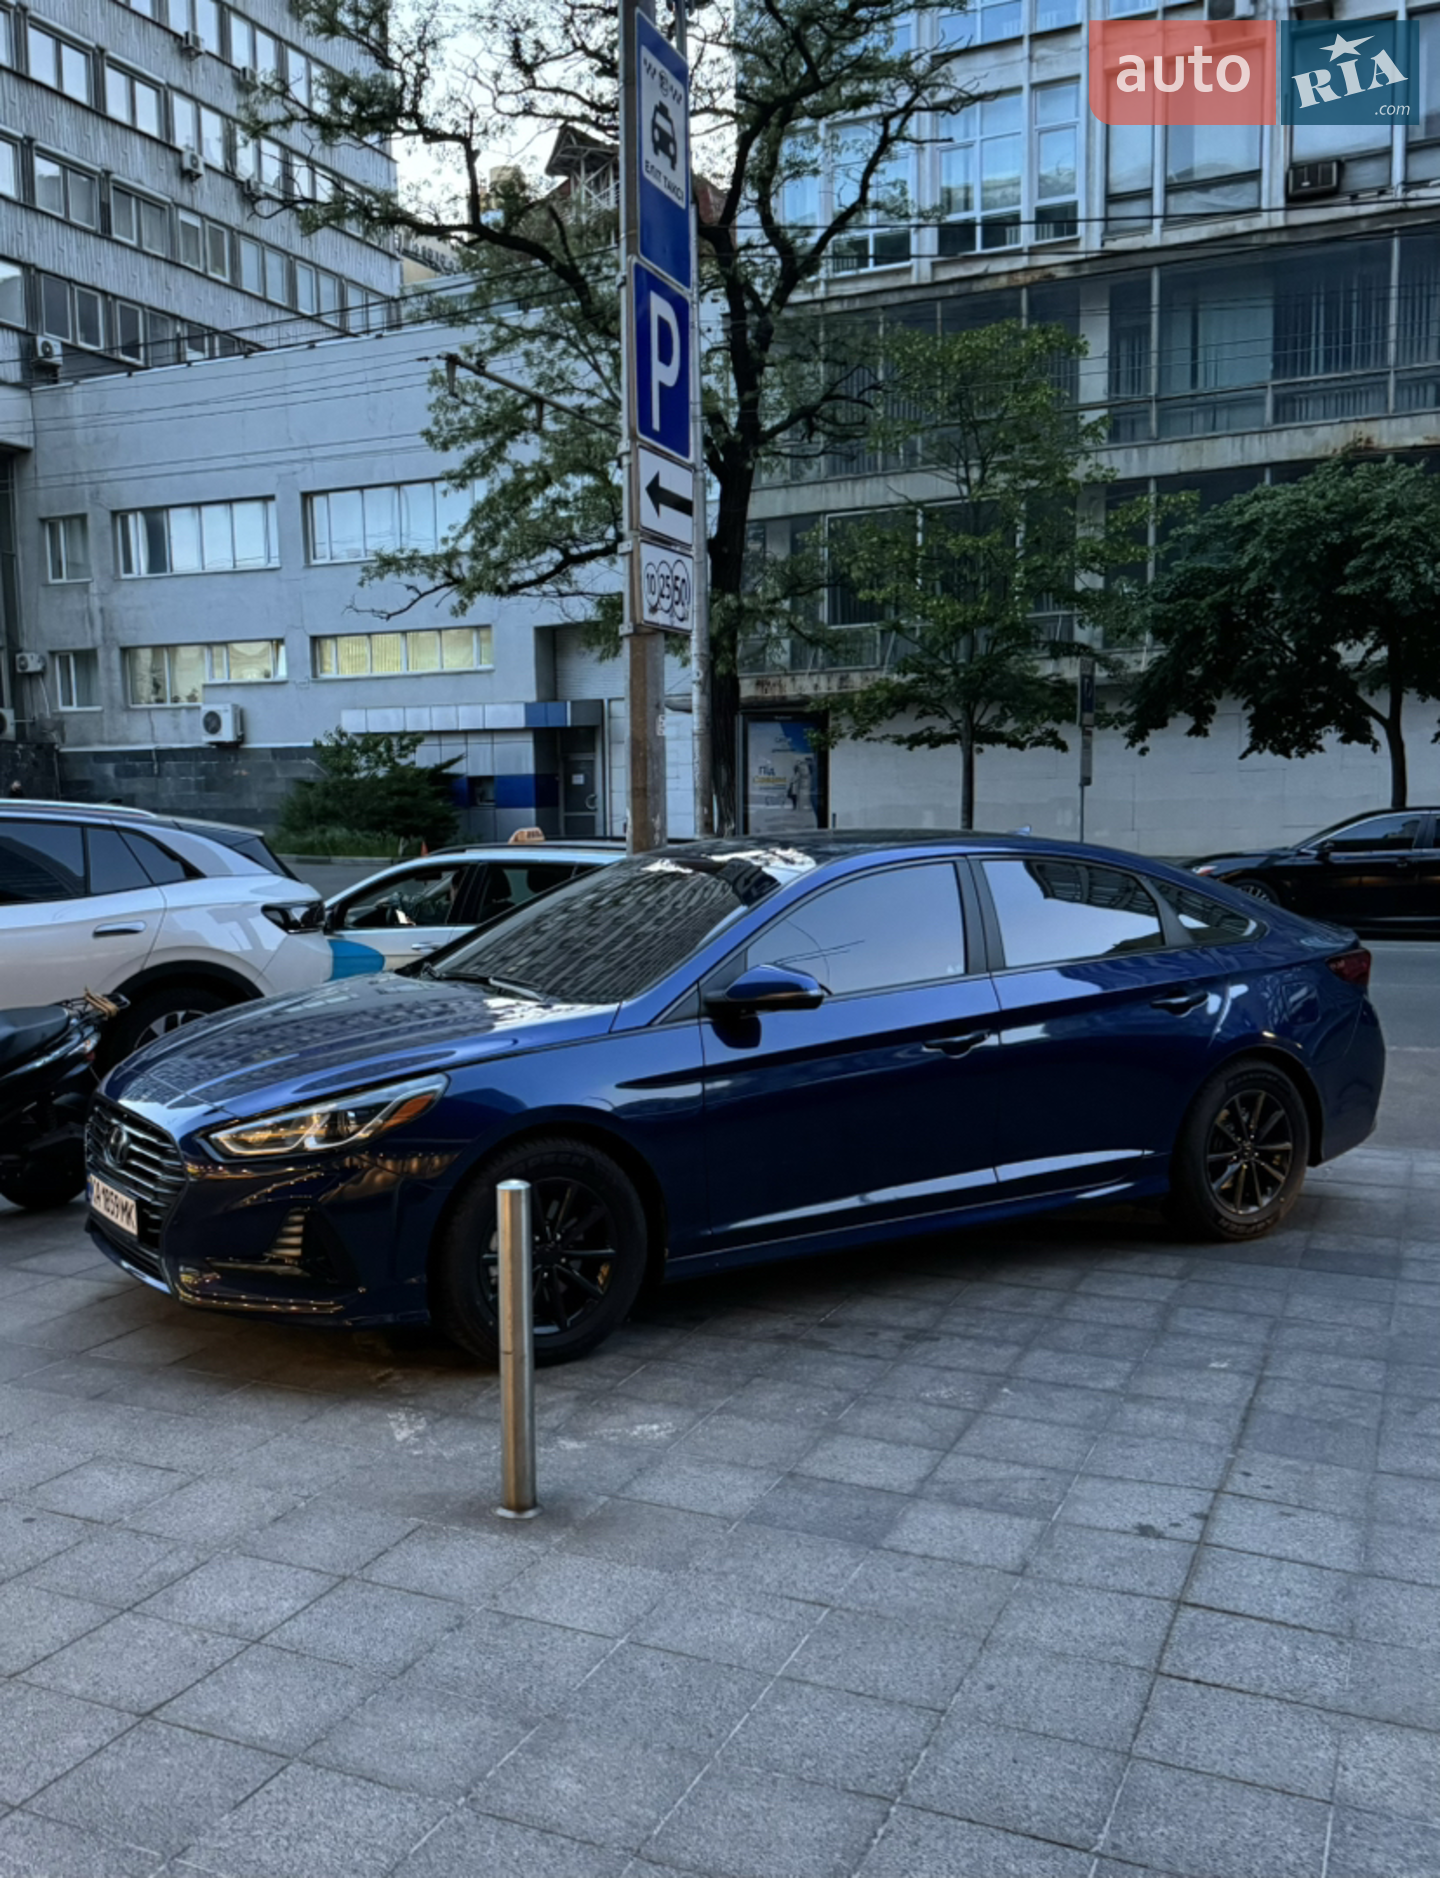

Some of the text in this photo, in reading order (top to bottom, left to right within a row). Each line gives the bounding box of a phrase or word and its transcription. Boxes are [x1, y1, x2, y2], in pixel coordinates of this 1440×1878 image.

[650, 290, 681, 433] P
[646, 573, 688, 607] 10 25 50
